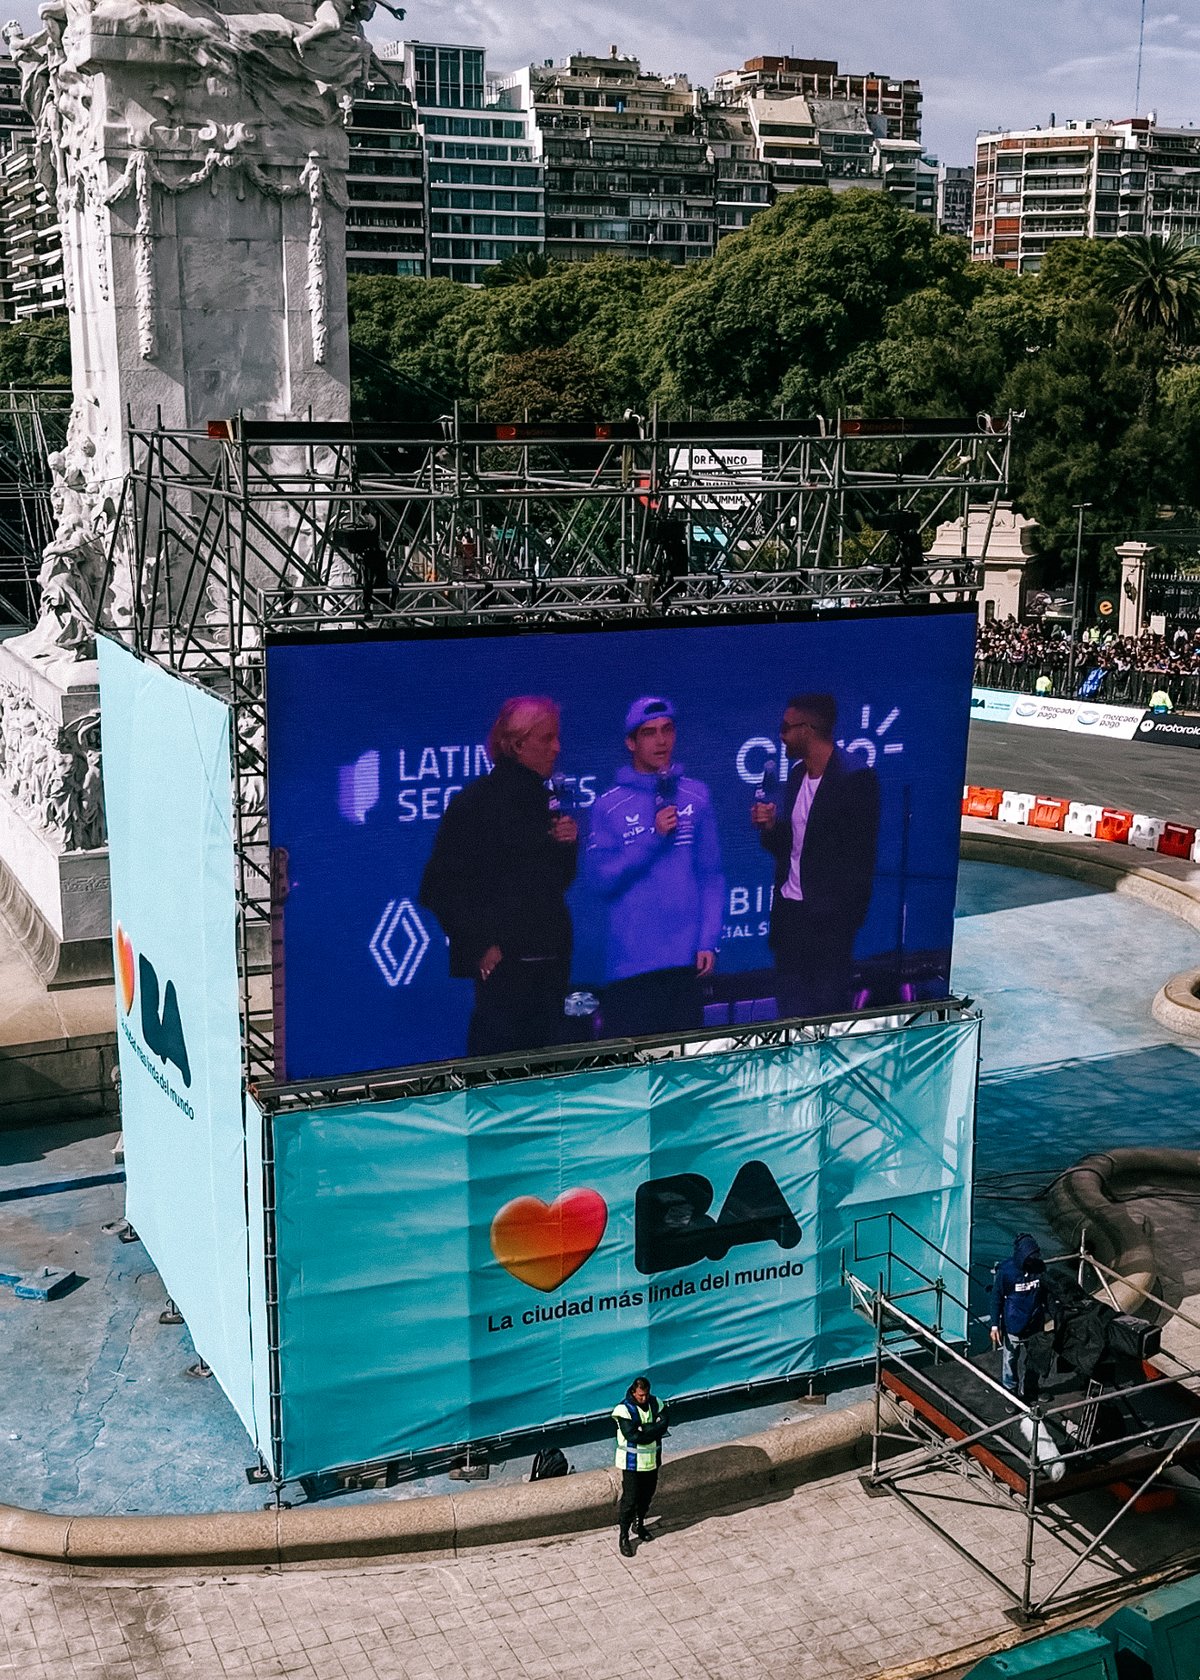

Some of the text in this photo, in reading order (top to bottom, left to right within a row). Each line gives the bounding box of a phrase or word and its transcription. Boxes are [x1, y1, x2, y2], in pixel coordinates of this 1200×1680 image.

[1037, 711, 1057, 720] pago
[1040, 705, 1075, 715] mercado
[1103, 713, 1139, 724] mercado
[1099, 720, 1120, 729] pago
[139, 952, 192, 1089] BA
[170, 1088, 195, 1121] mundo
[634, 1160, 803, 1276] BA
[488, 1260, 804, 1333] La ciudad más linda del mundo
